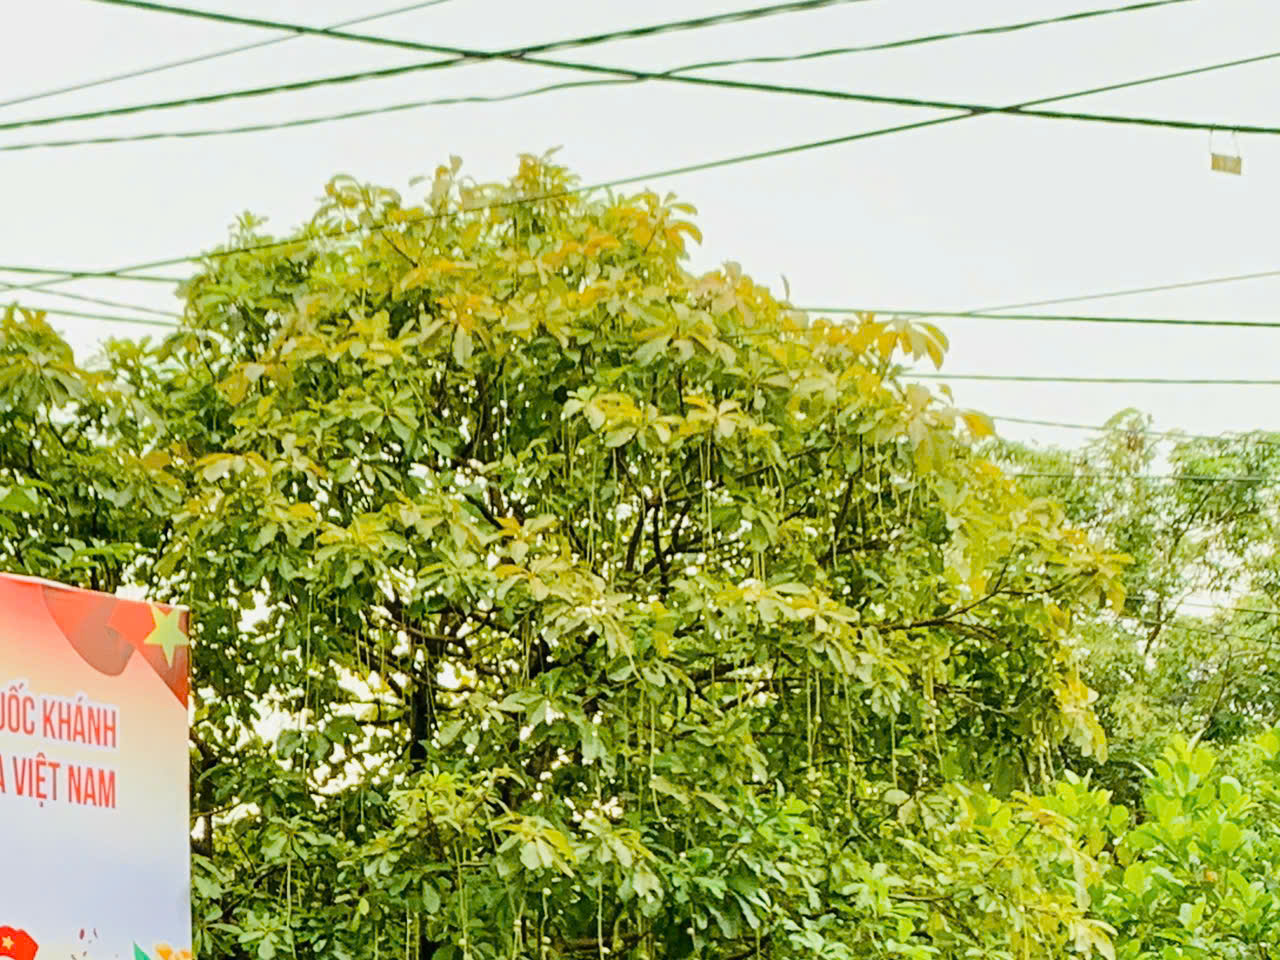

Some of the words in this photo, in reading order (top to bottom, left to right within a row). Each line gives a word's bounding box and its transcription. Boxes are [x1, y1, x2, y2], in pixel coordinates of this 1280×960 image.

[42, 695, 118, 749] KHÁNH
[12, 751, 60, 808] VIỆT
[68, 765, 117, 809] NAM
